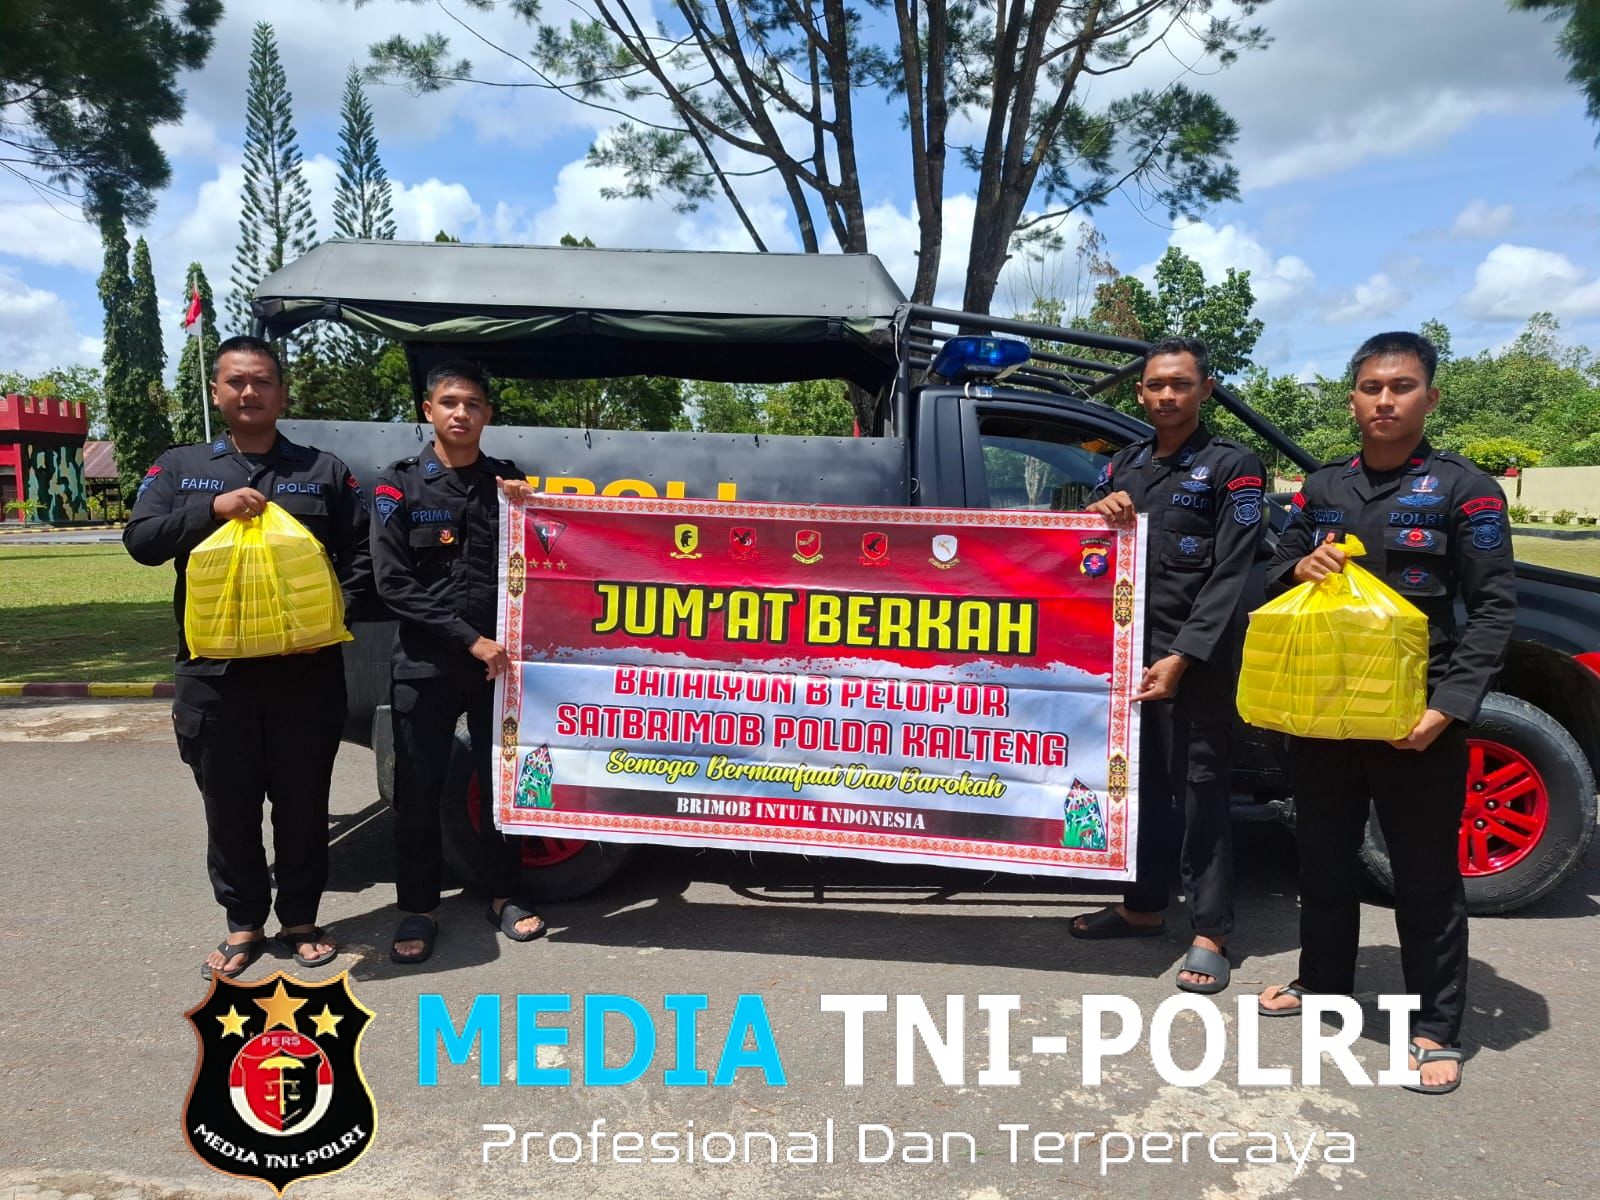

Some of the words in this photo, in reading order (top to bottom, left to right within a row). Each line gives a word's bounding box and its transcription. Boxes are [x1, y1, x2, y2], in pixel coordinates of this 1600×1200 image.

[181, 478, 224, 490] FAHRI
[277, 483, 320, 494] POLRI
[1172, 493, 1212, 509] POLR
[411, 510, 453, 523] PRIMA
[594, 583, 794, 642] JUM'AT
[806, 593, 1034, 655] BERKAH
[804, 675, 831, 706] B
[840, 676, 1009, 717] PELOPOR
[556, 703, 763, 748] SATBRIMOB
[773, 717, 891, 756] POLDA
[900, 723, 1069, 768] KALTENG
[606, 749, 700, 784] Semoga
[705, 755, 844, 792] Bermanfaat
[843, 762, 898, 790] Dan
[898, 766, 1007, 798] Barokah
[676, 796, 751, 817] BRIMOB
[822, 806, 926, 831] INDONESIA
